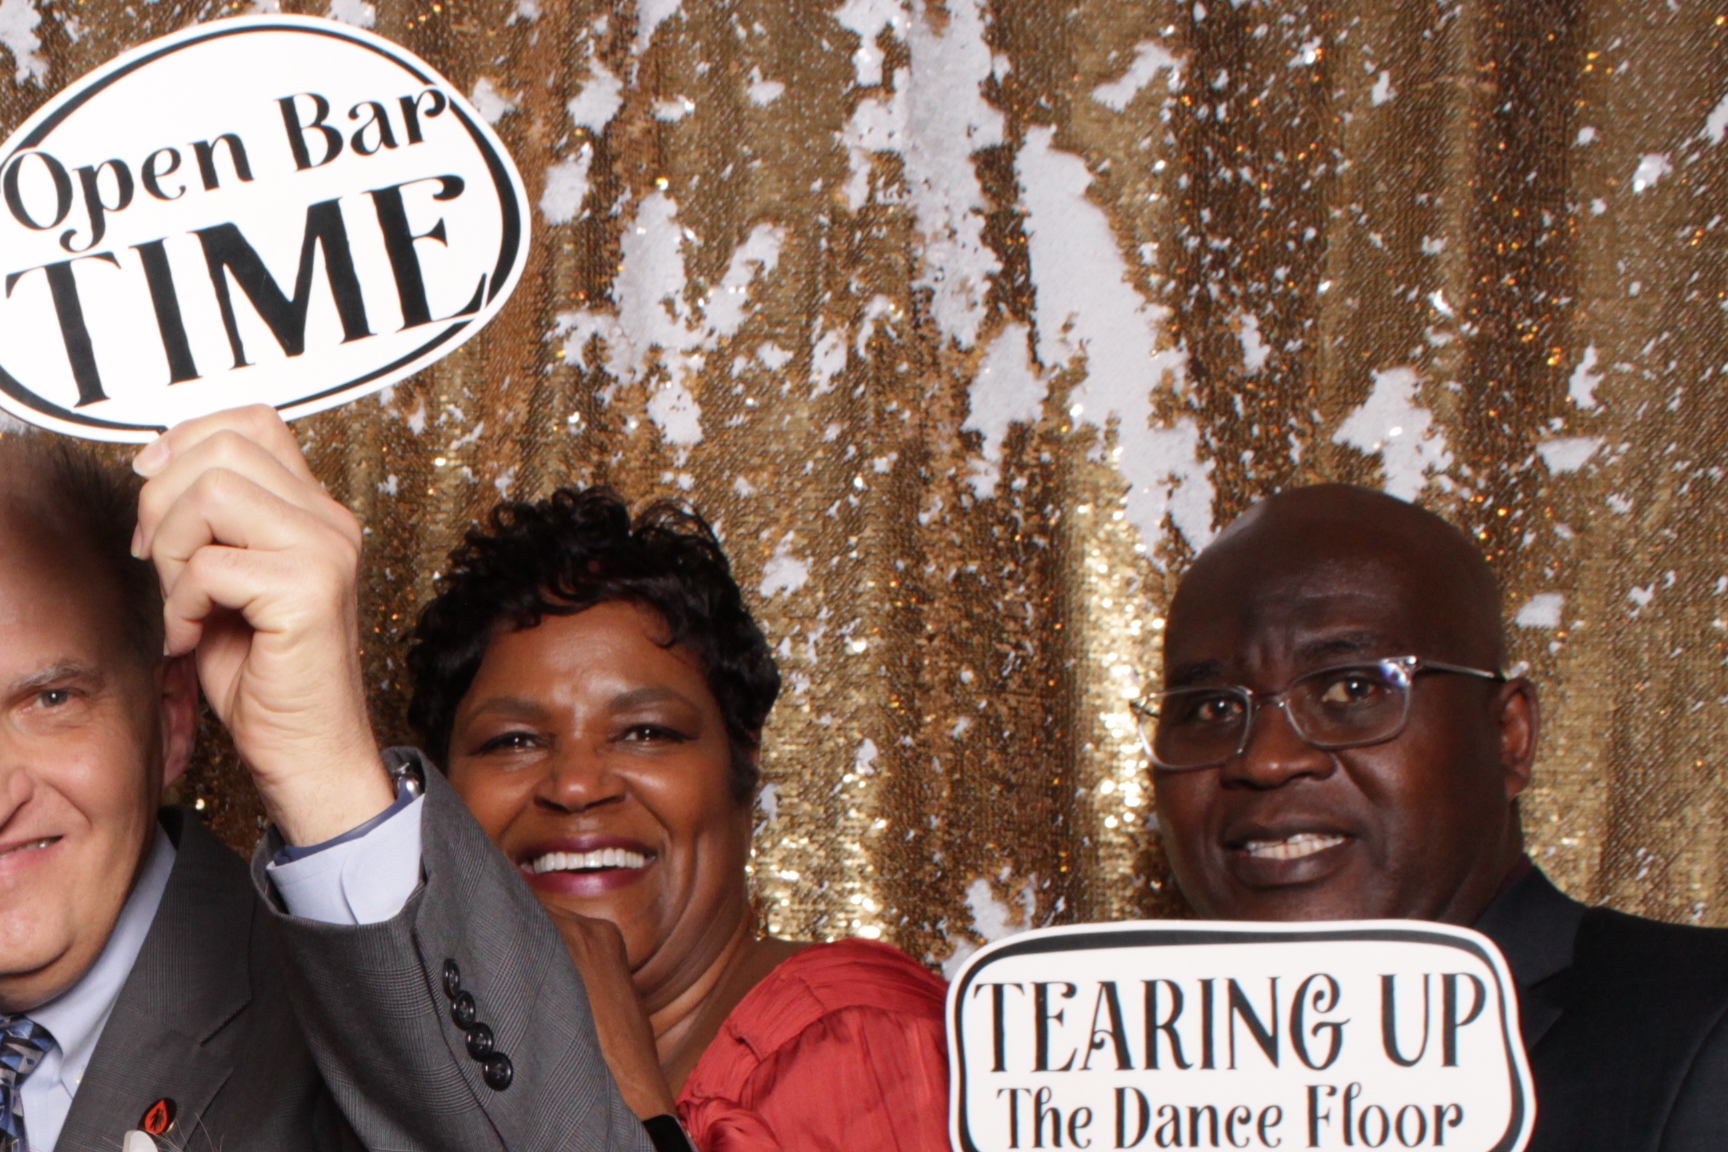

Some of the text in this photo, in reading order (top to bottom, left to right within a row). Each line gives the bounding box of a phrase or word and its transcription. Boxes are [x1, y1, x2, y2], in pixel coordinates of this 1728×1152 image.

[2, 87, 447, 254] Open Bar
[5, 174, 488, 408] TIME
[974, 972, 1487, 1074] TEARING UP
[997, 1081, 1464, 1150] The Dance Floor
